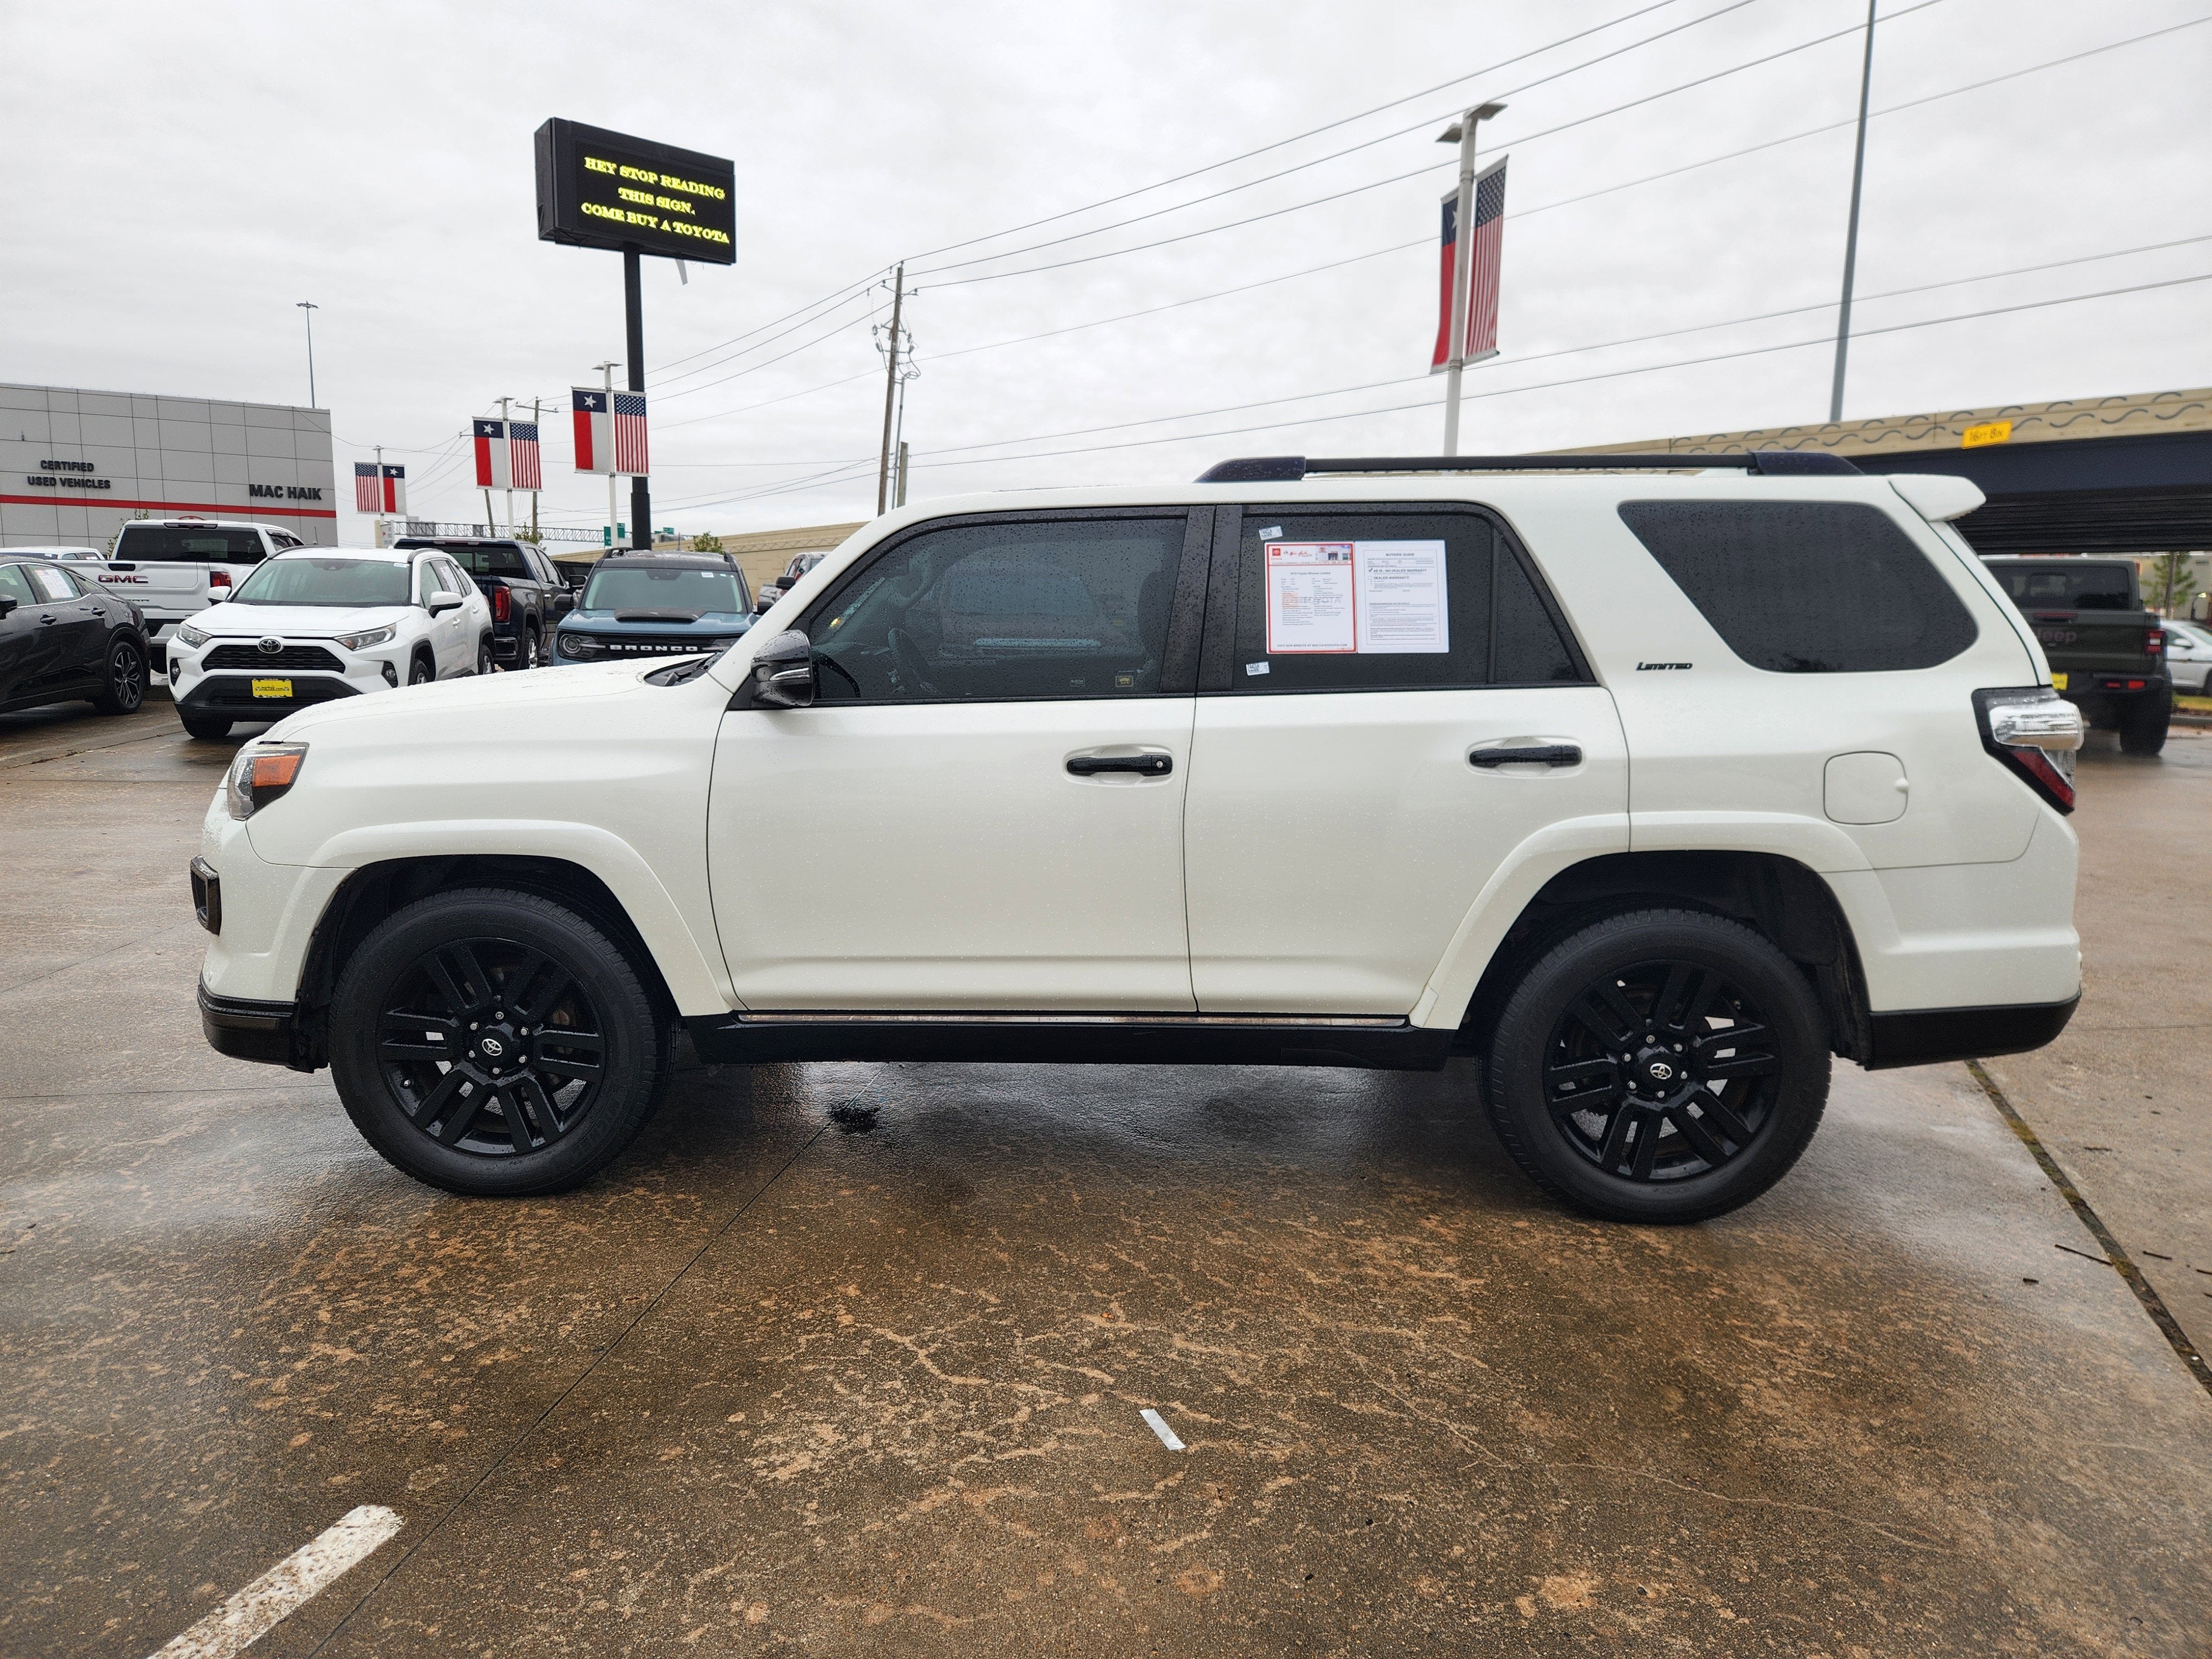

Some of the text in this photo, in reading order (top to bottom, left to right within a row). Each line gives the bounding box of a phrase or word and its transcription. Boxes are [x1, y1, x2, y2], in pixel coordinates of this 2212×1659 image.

[584, 156, 726, 200] HEY STOP READING
[618, 186, 696, 215] THIS SIGN.
[581, 202, 731, 244] COME BUY A TOYOTA
[40, 460, 94, 472] CERTIFIED
[27, 476, 111, 489] USED VEHICLES
[249, 484, 322, 500] MAC HAIK
[98, 575, 149, 584] GMC
[609, 639, 698, 651] BRONCO
